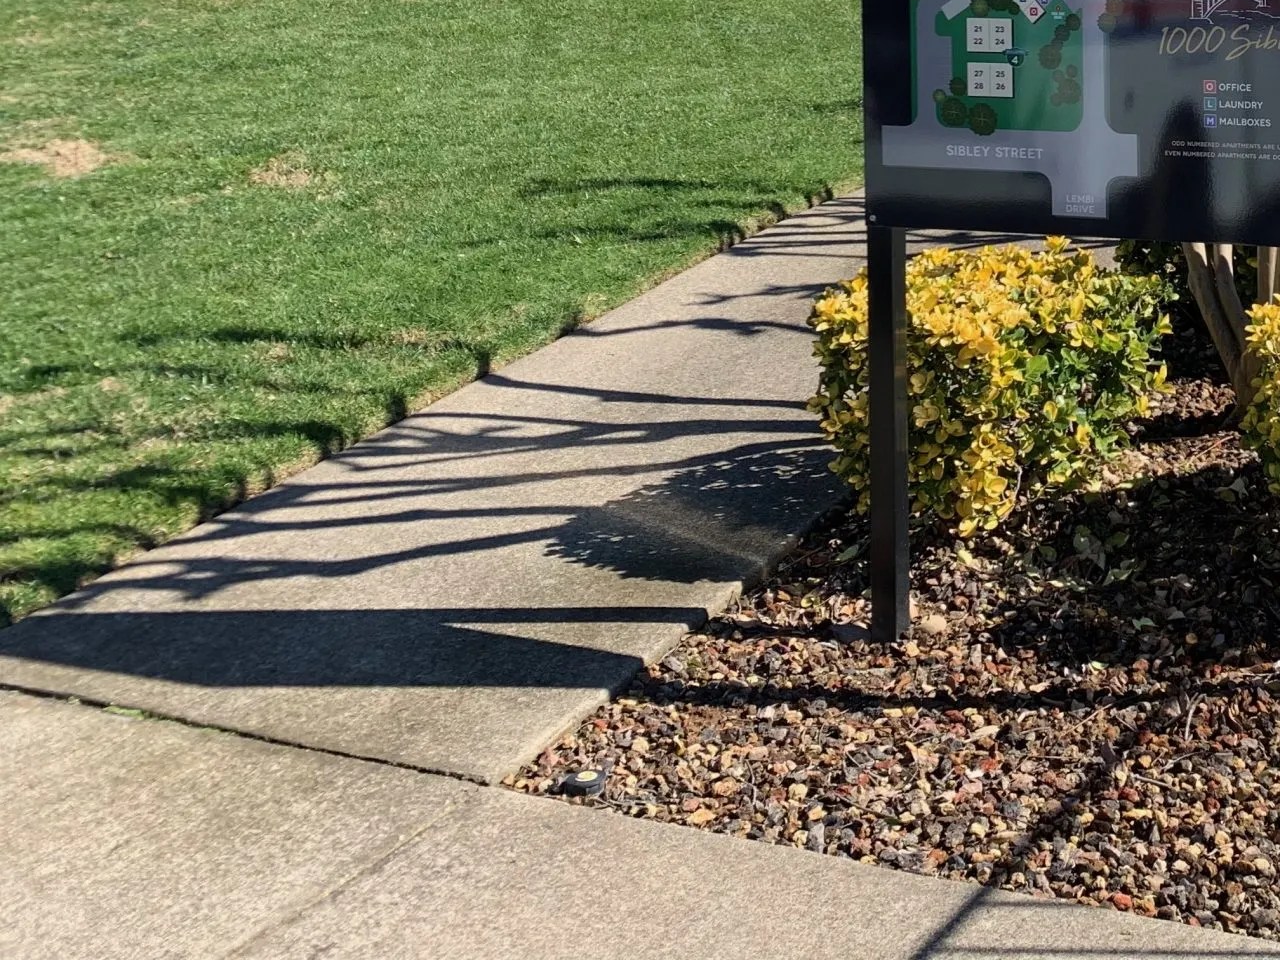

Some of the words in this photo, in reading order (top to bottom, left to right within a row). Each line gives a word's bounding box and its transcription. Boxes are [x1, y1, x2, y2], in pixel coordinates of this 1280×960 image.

[974, 25, 982, 33] 21
[1159, 25, 1226, 55] 1000
[1011, 55, 1018, 65] 4
[974, 82, 984, 90] 28
[1218, 83, 1252, 92] OFFICE
[1218, 100, 1263, 109] LAUNDRY
[1219, 117, 1271, 127] MAILBOXES
[946, 145, 991, 157] SIBLEY
[995, 147, 1044, 159] STREET
[1066, 194, 1095, 204] LEMBI
[1065, 204, 1096, 214] DRIVE
